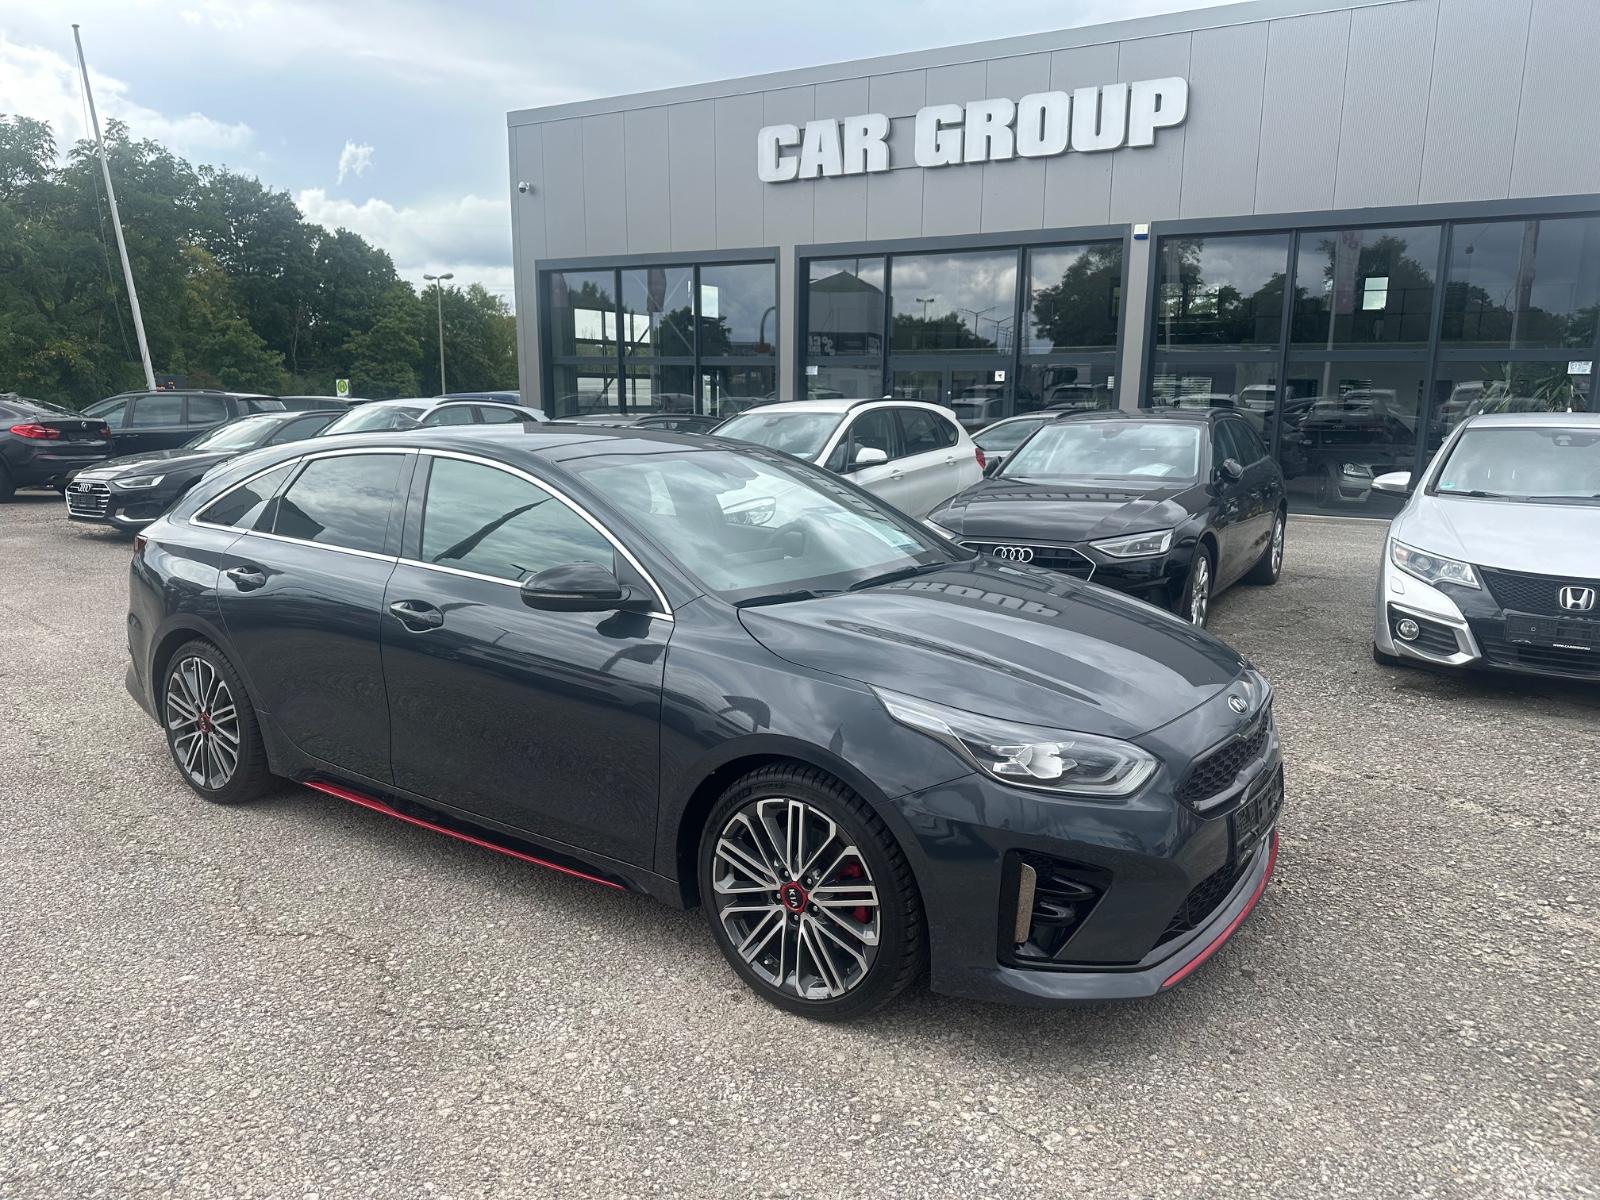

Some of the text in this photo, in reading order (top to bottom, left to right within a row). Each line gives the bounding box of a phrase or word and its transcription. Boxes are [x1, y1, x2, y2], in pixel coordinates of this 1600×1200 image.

[757, 76, 1190, 183] CAR GROUP
[788, 888, 798, 907] KIA
